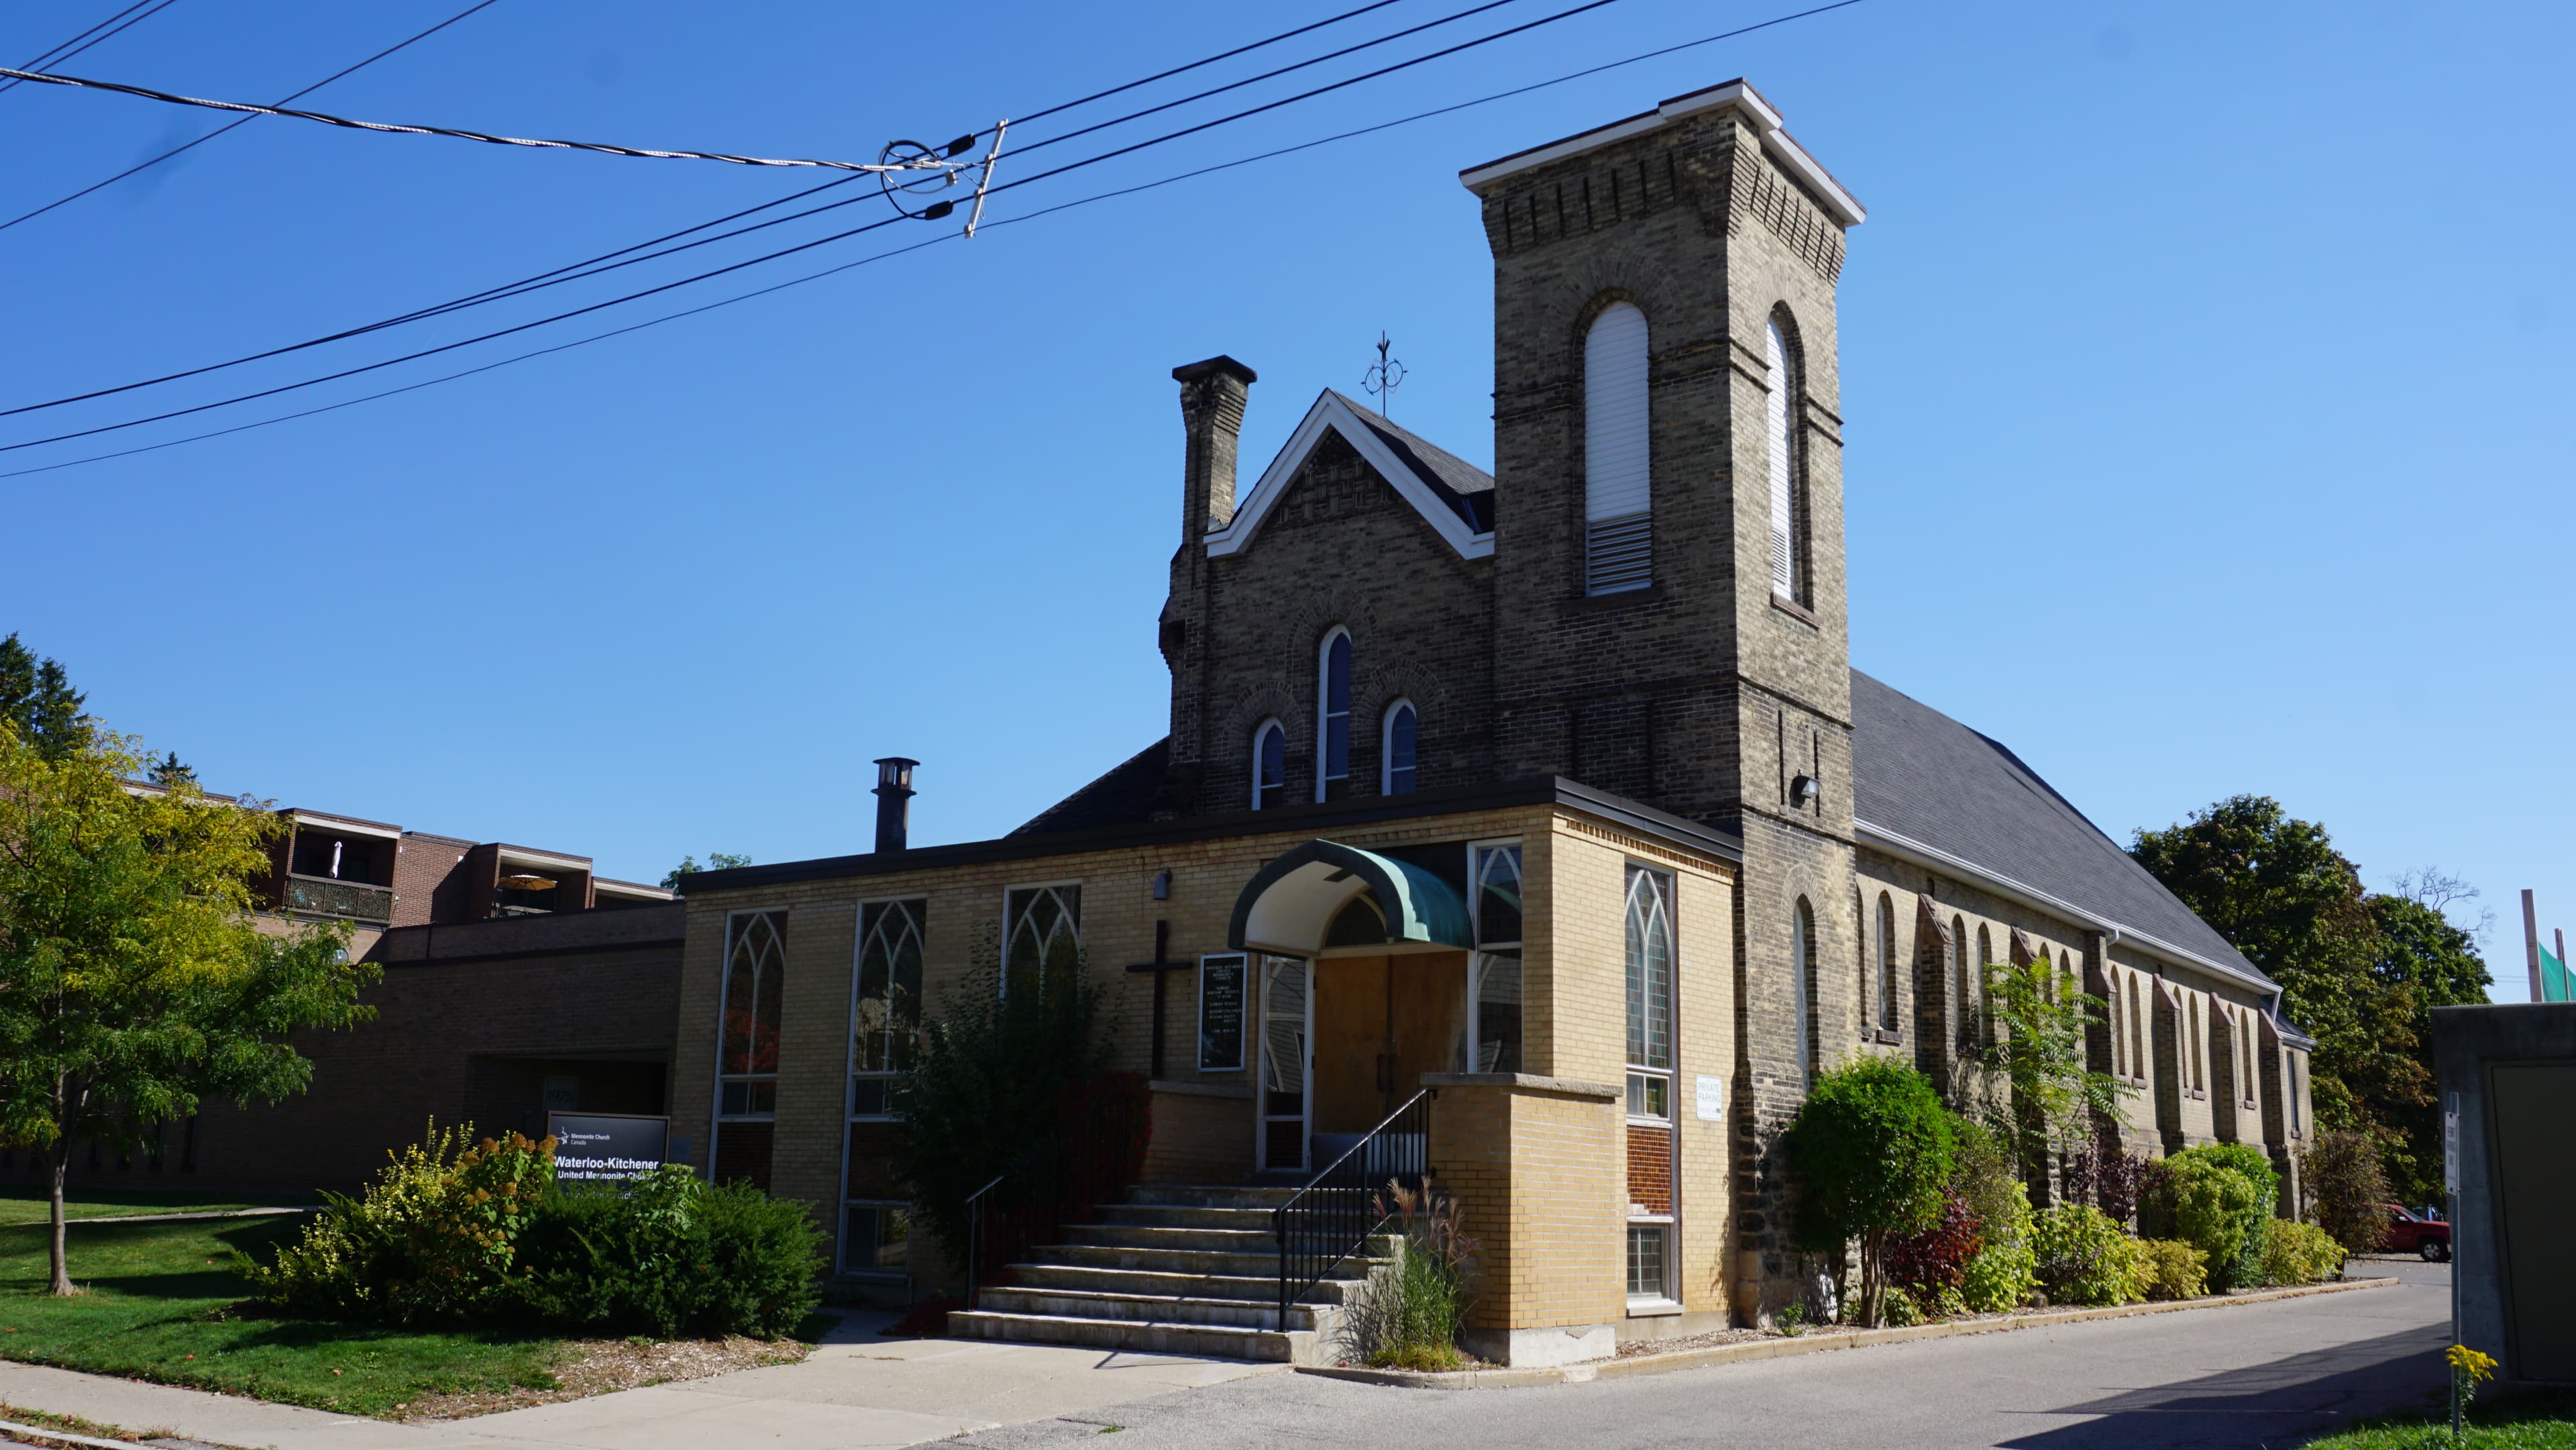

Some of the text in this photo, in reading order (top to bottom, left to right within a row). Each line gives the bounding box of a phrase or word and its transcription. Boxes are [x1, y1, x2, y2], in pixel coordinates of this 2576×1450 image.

[1699, 1082, 1719, 1092] PRIVATE
[1699, 1093, 1721, 1103] PARKING
[555, 1155, 659, 1170] Waterloo-Kitchener
[558, 1170, 584, 1179] United
